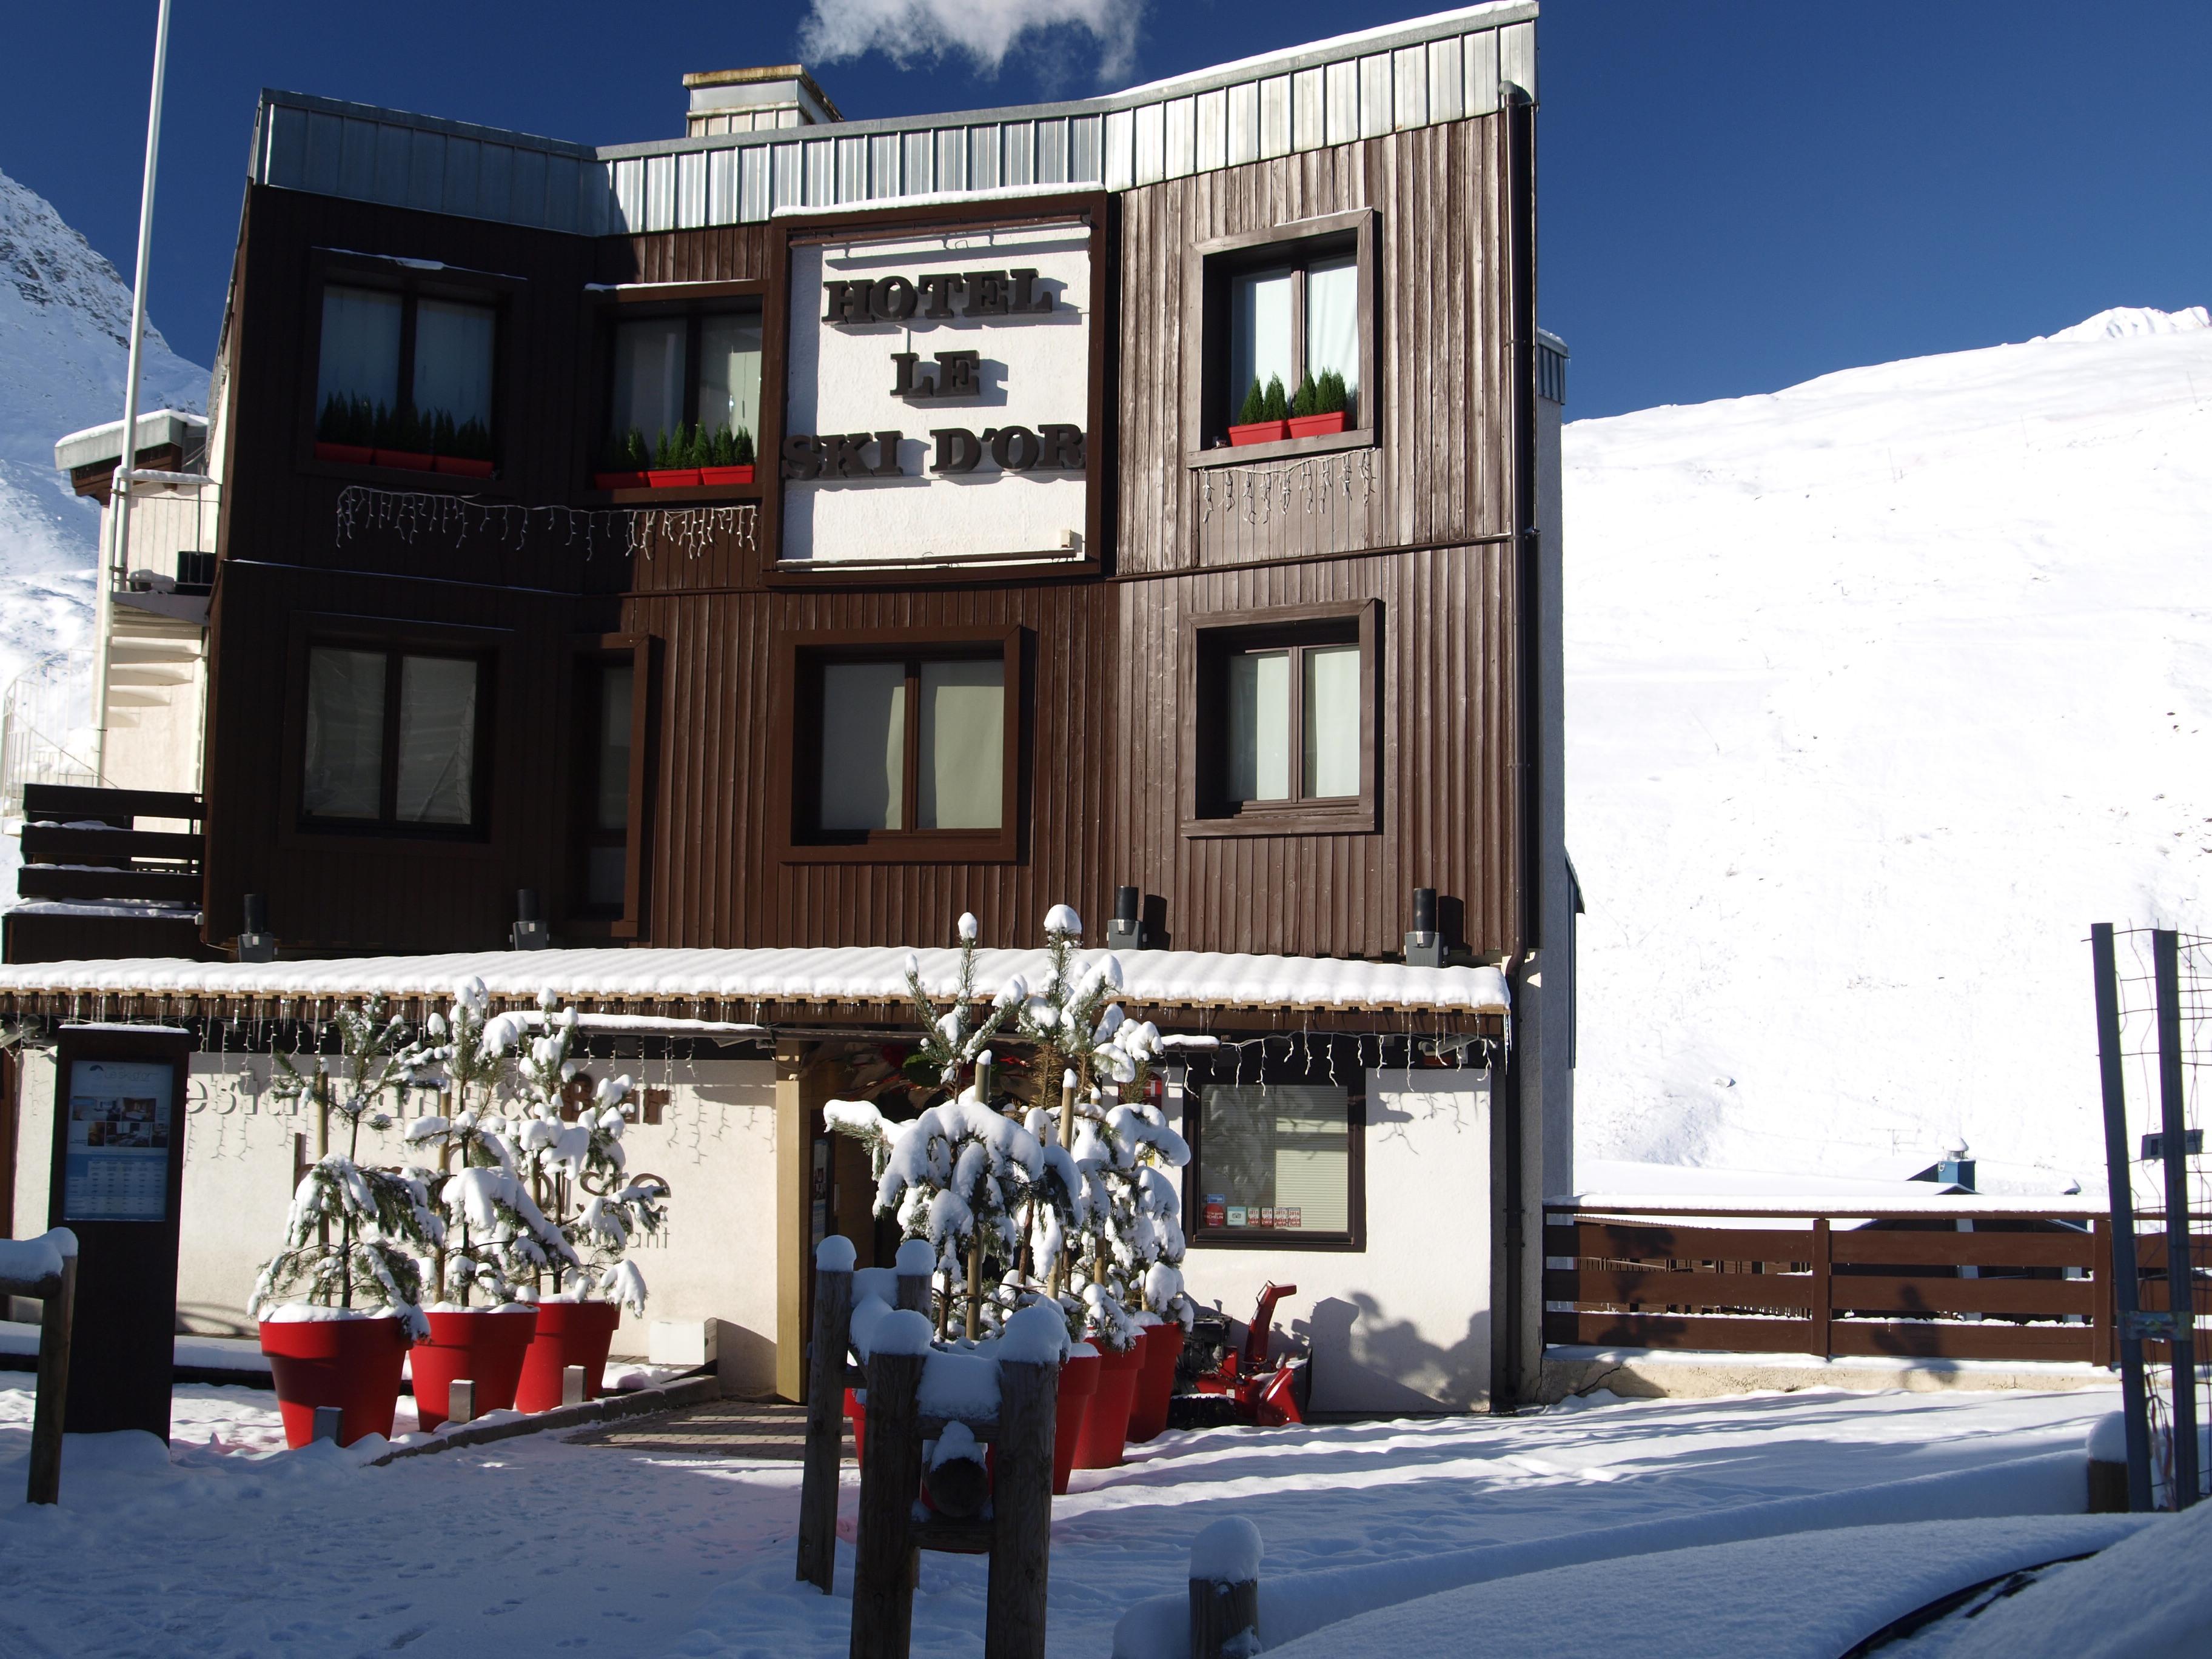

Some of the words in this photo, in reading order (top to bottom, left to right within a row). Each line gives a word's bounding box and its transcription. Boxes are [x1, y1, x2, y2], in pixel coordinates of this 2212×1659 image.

[822, 268, 1053, 324] HOTEL
[890, 350, 980, 398] LE
[782, 431, 903, 481] SKI
[929, 423, 1087, 474] D'OR
